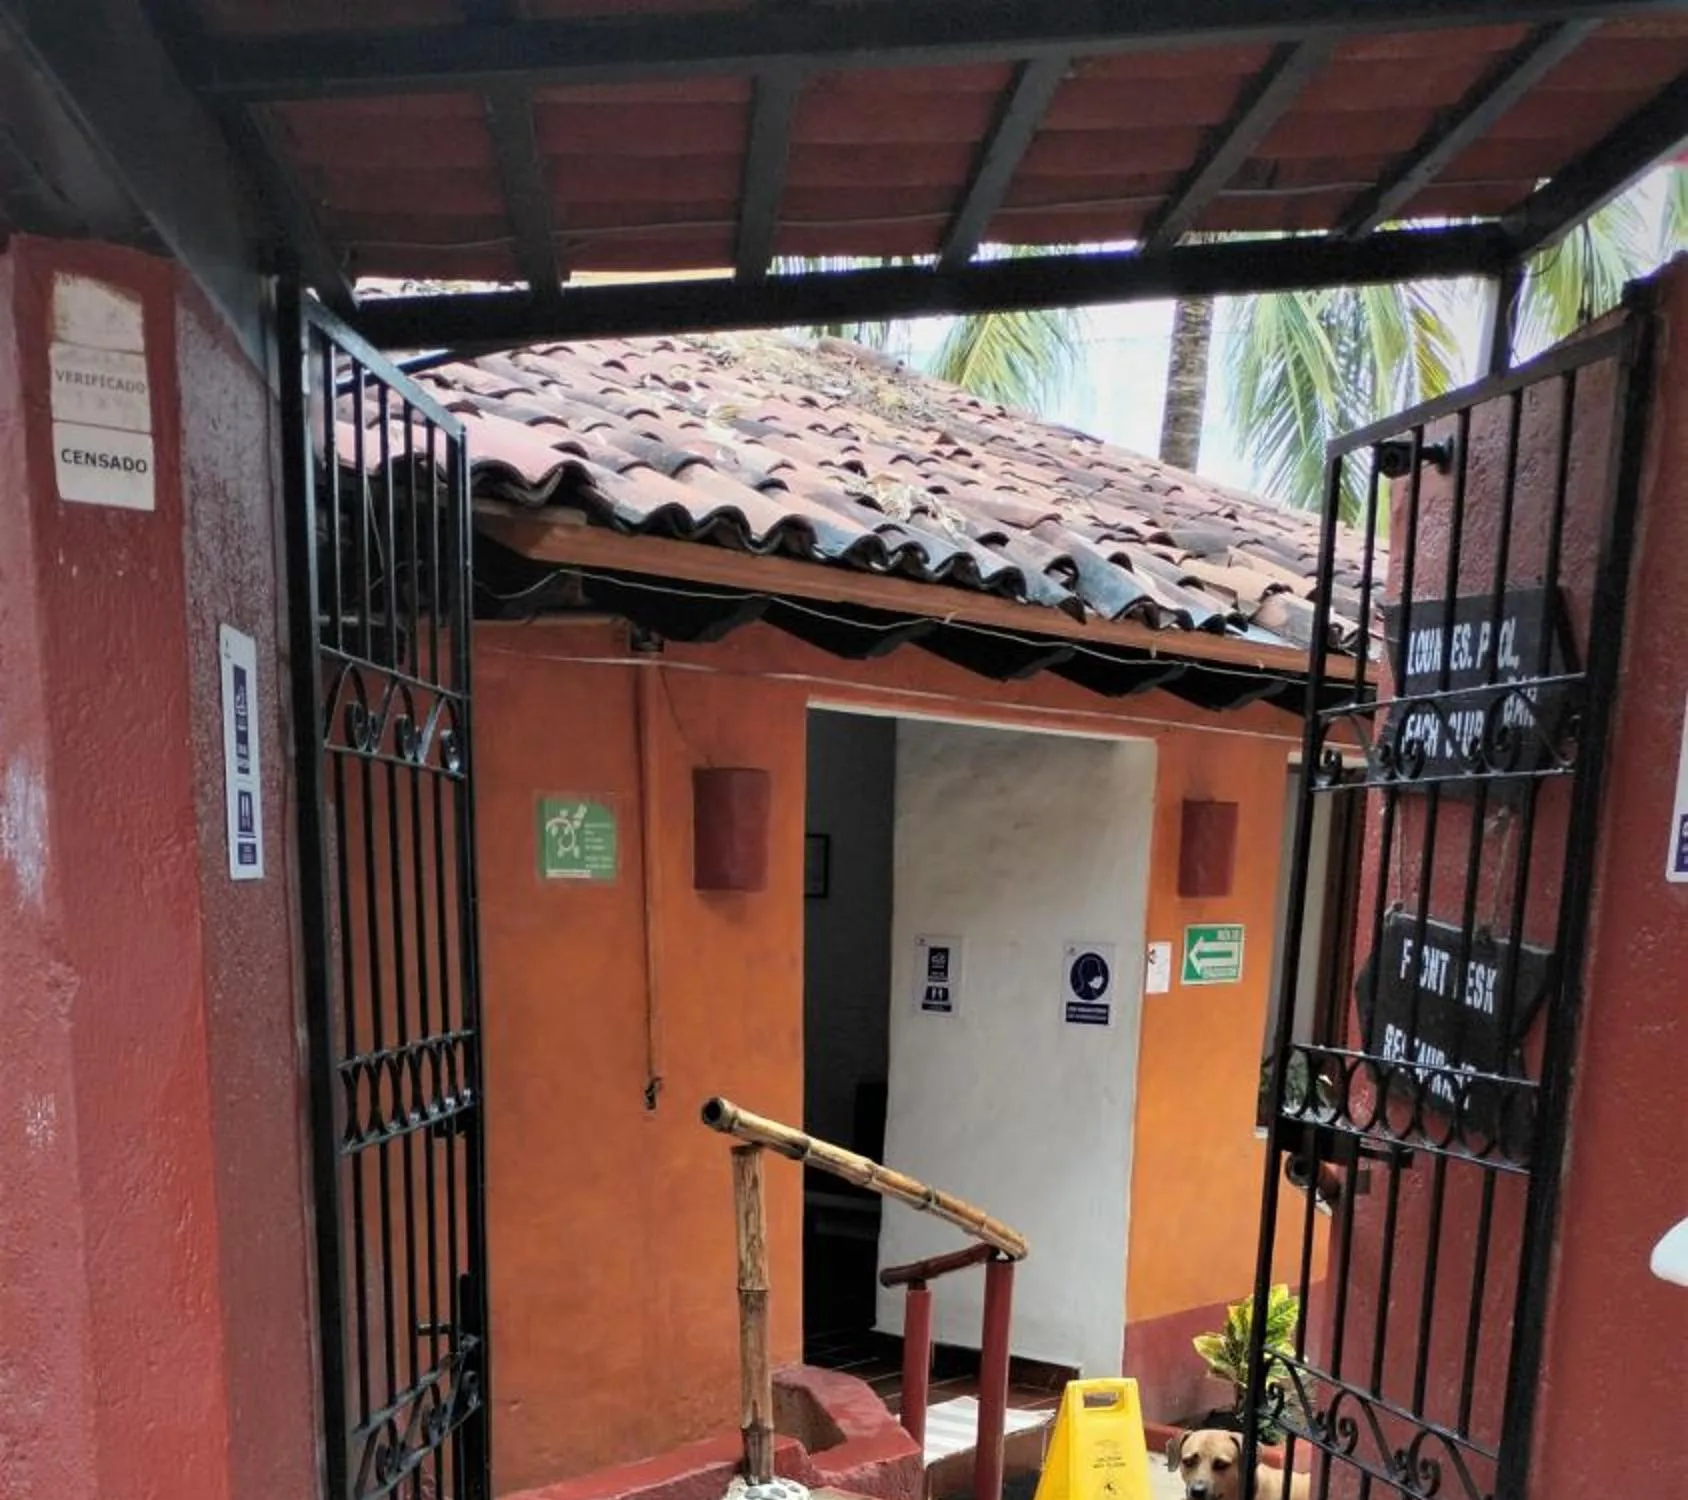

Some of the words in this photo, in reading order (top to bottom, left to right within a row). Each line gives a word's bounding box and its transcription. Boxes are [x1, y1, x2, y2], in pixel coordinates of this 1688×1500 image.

[55, 367, 147, 395] VERIFICADO
[61, 447, 148, 474] CENSADO
[1475, 617, 1520, 670] POL,
[1400, 713, 1440, 757] EACH
[1400, 938, 1450, 996] FONT
[1452, 960, 1498, 1015] ESK
